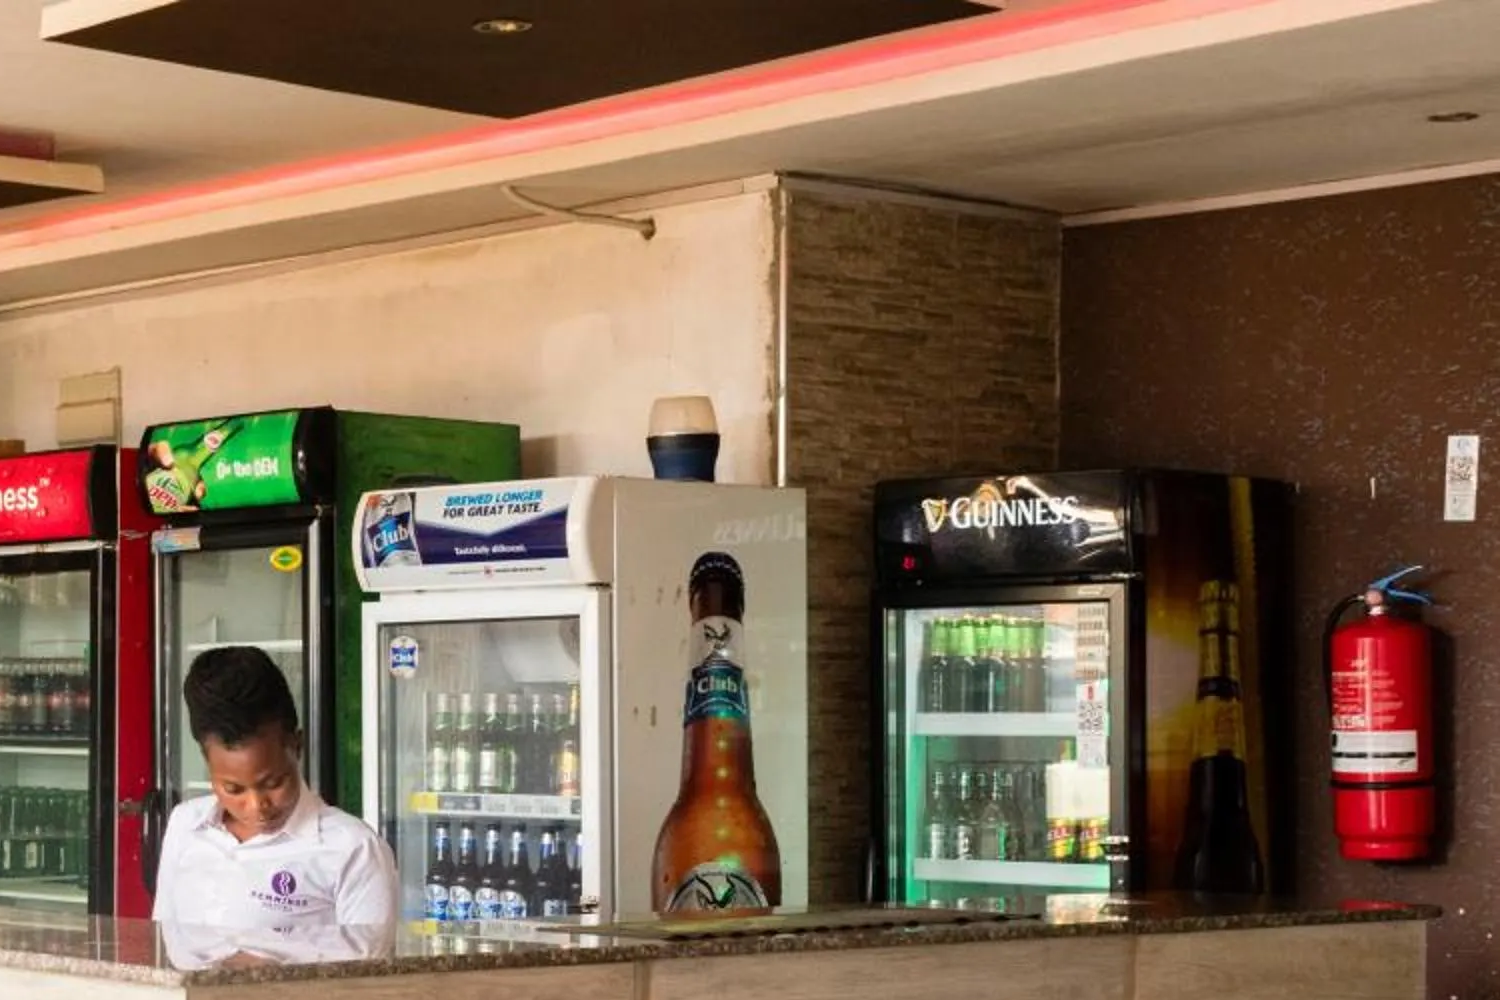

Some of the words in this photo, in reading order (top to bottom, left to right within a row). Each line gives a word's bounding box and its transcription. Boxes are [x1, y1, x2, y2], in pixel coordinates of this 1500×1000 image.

[444, 493, 493, 507] BREWED
[495, 490, 544, 504] LONGER
[443, 507, 466, 519] FOR
[468, 505, 504, 517] GREAT
[950, 496, 1080, 529] GUINNESS
[373, 525, 410, 551] Club
[697, 675, 739, 693] Club
